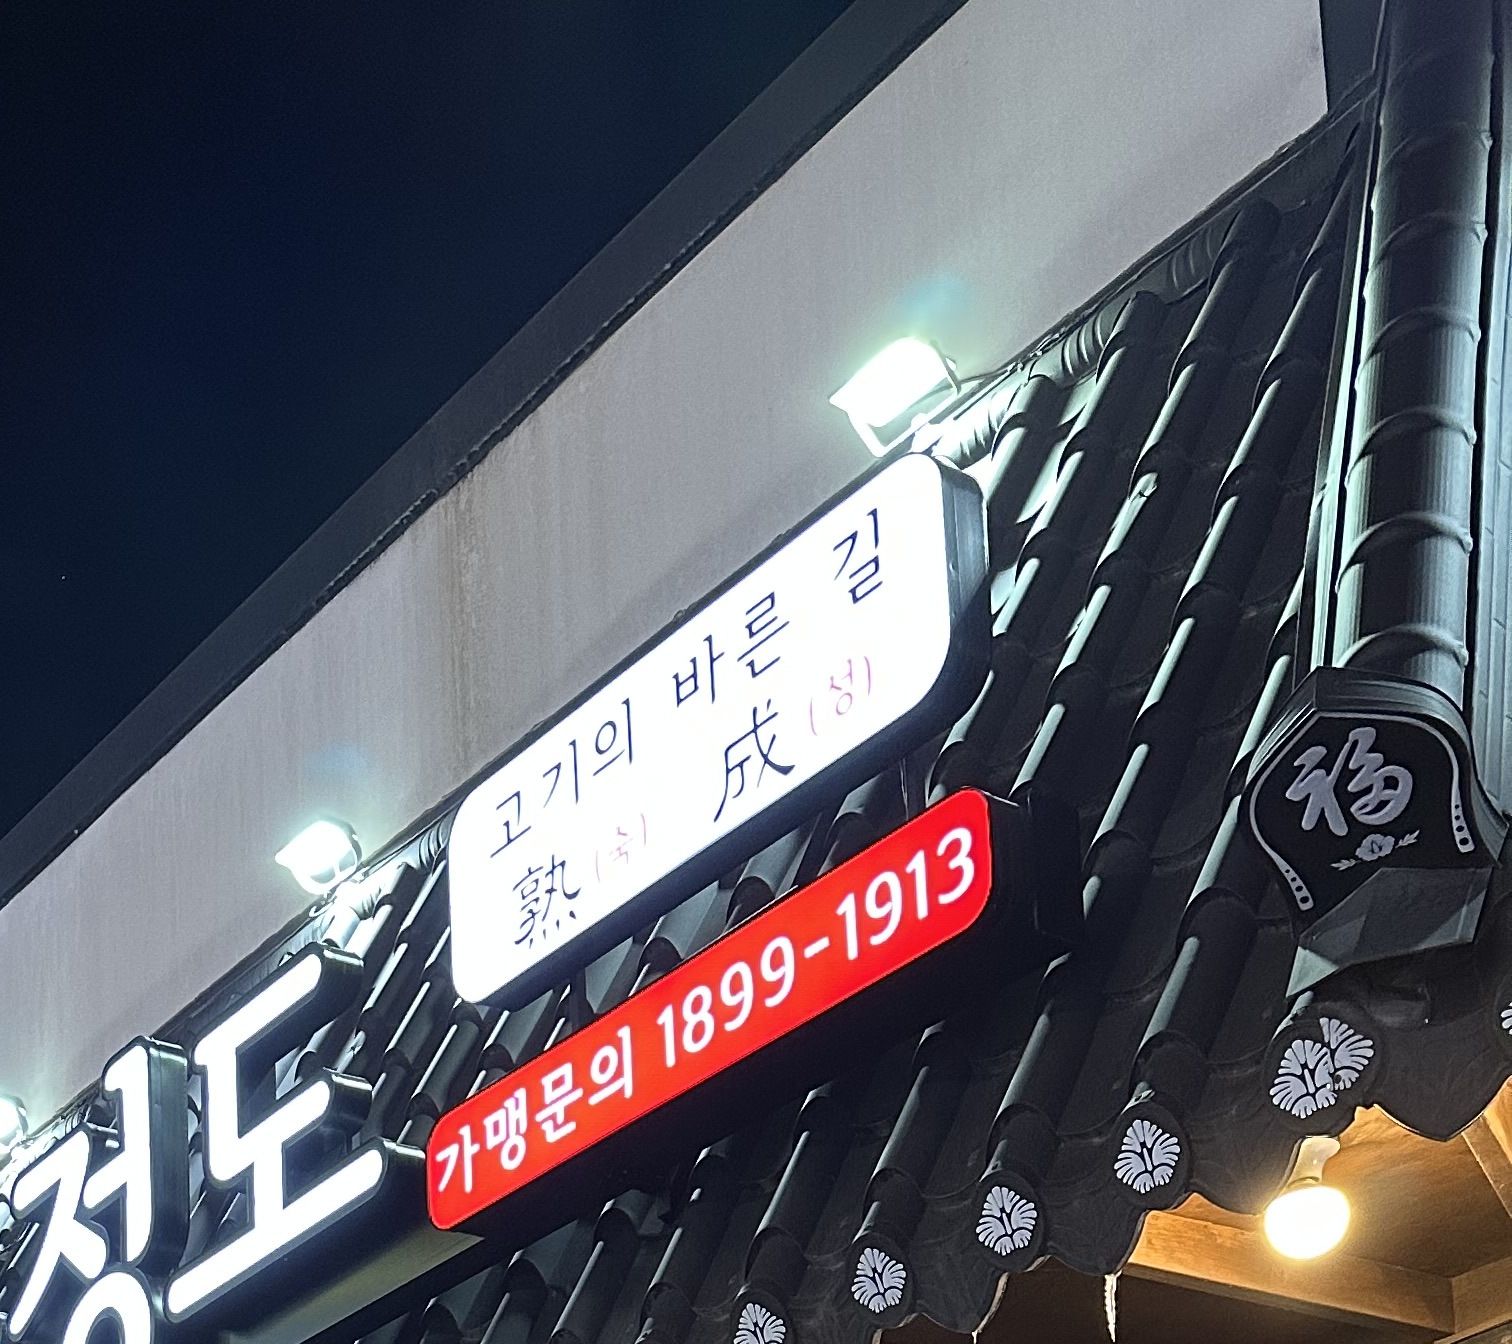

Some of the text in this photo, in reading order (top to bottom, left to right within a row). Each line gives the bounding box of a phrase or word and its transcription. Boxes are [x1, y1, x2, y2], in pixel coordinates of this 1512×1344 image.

[489, 507, 882, 858] 고기의 바른 길
[512, 853, 582, 949] 熟
[714, 698, 795, 823] 成
[1285, 726, 1414, 837] 福
[435, 826, 977, 1197] 가맹문의 1899-1913
